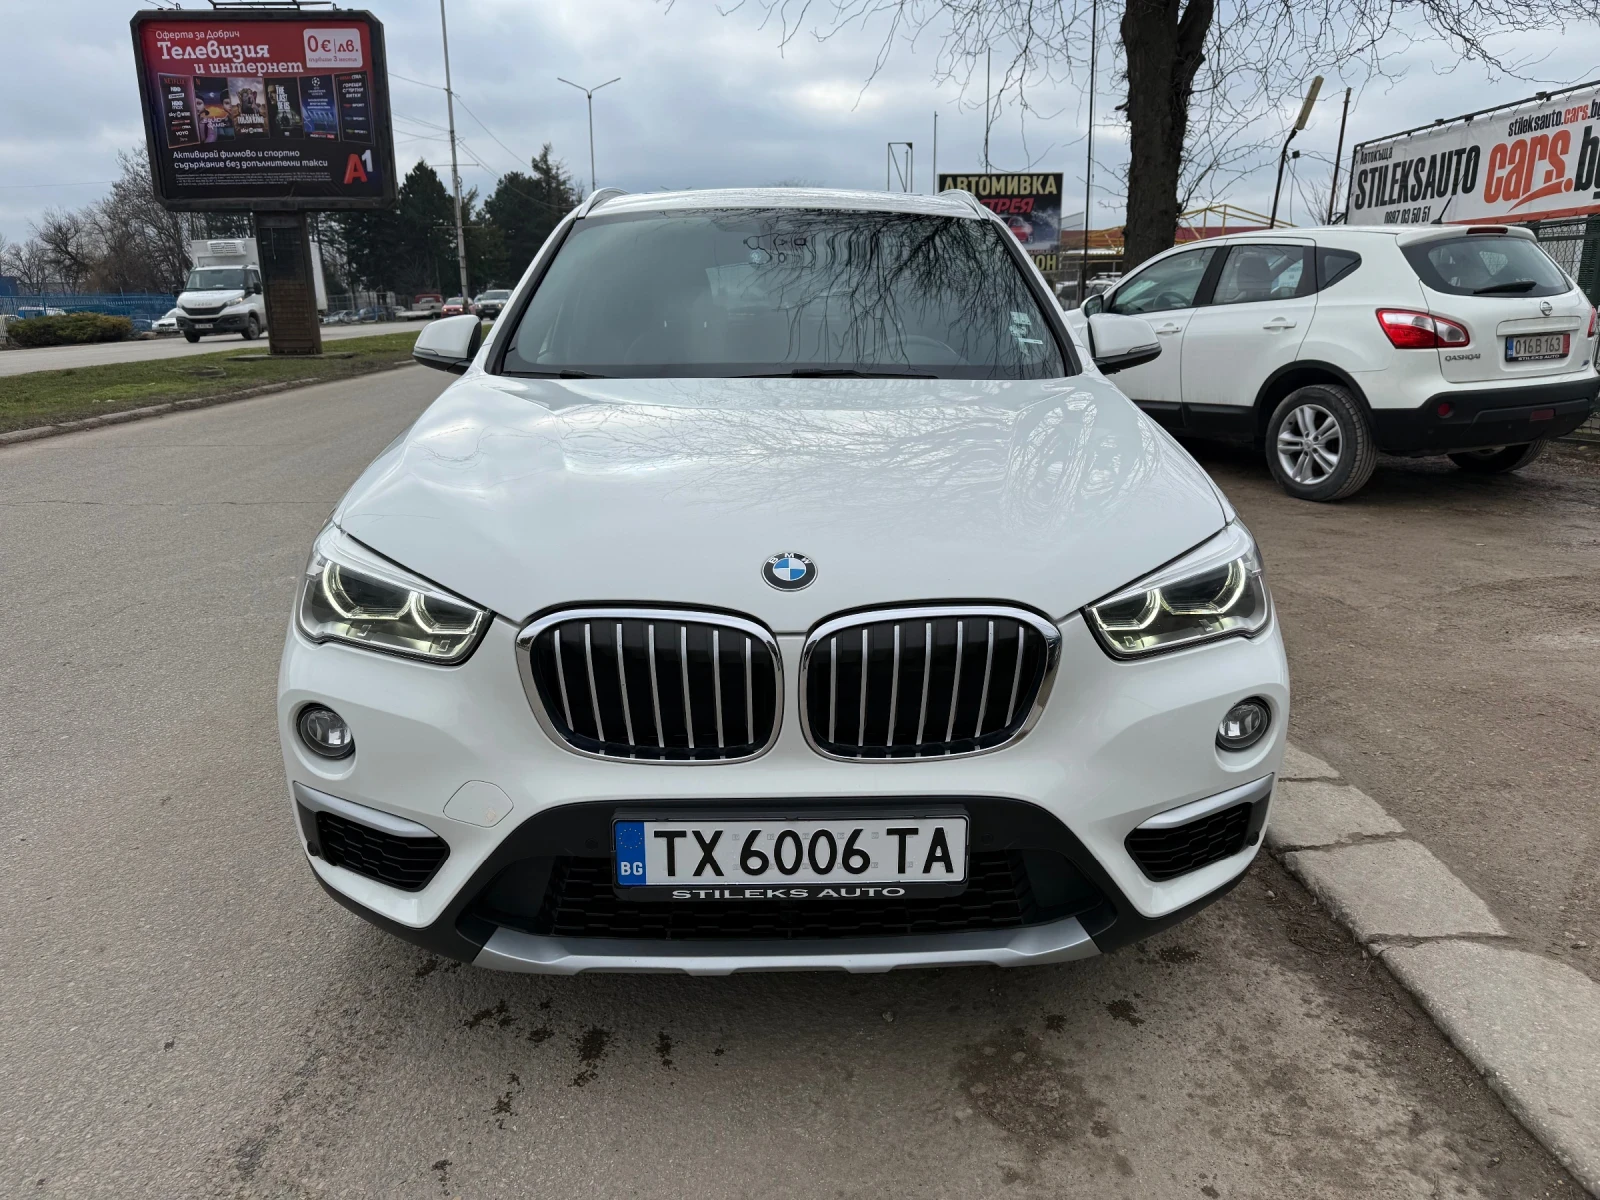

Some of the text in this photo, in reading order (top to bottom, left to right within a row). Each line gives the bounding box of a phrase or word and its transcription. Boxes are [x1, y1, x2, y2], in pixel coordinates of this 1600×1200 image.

[155, 29, 240, 40] Оферта за Добрич
[157, 40, 270, 62] Телевизия
[194, 61, 304, 77] и интернет
[173, 149, 219, 159] Активирай
[220, 149, 257, 159] филмово
[264, 150, 300, 158] спортно
[174, 159, 328, 170] съдържание без допълнителни такси
[944, 175, 1057, 196] АВТОМИВКА
[1354, 145, 1481, 210] STILEKSAUTO
[1411, 207, 1422, 223] 50
[1421, 205, 1432, 222] 51
[1514, 339, 1534, 355] 016
[1545, 336, 1561, 353] 163
[1445, 353, 1481, 362] QASHQAI
[620, 826, 954, 877] BG TX 6006 TA
[672, 886, 905, 899] STILEKS AUTO
